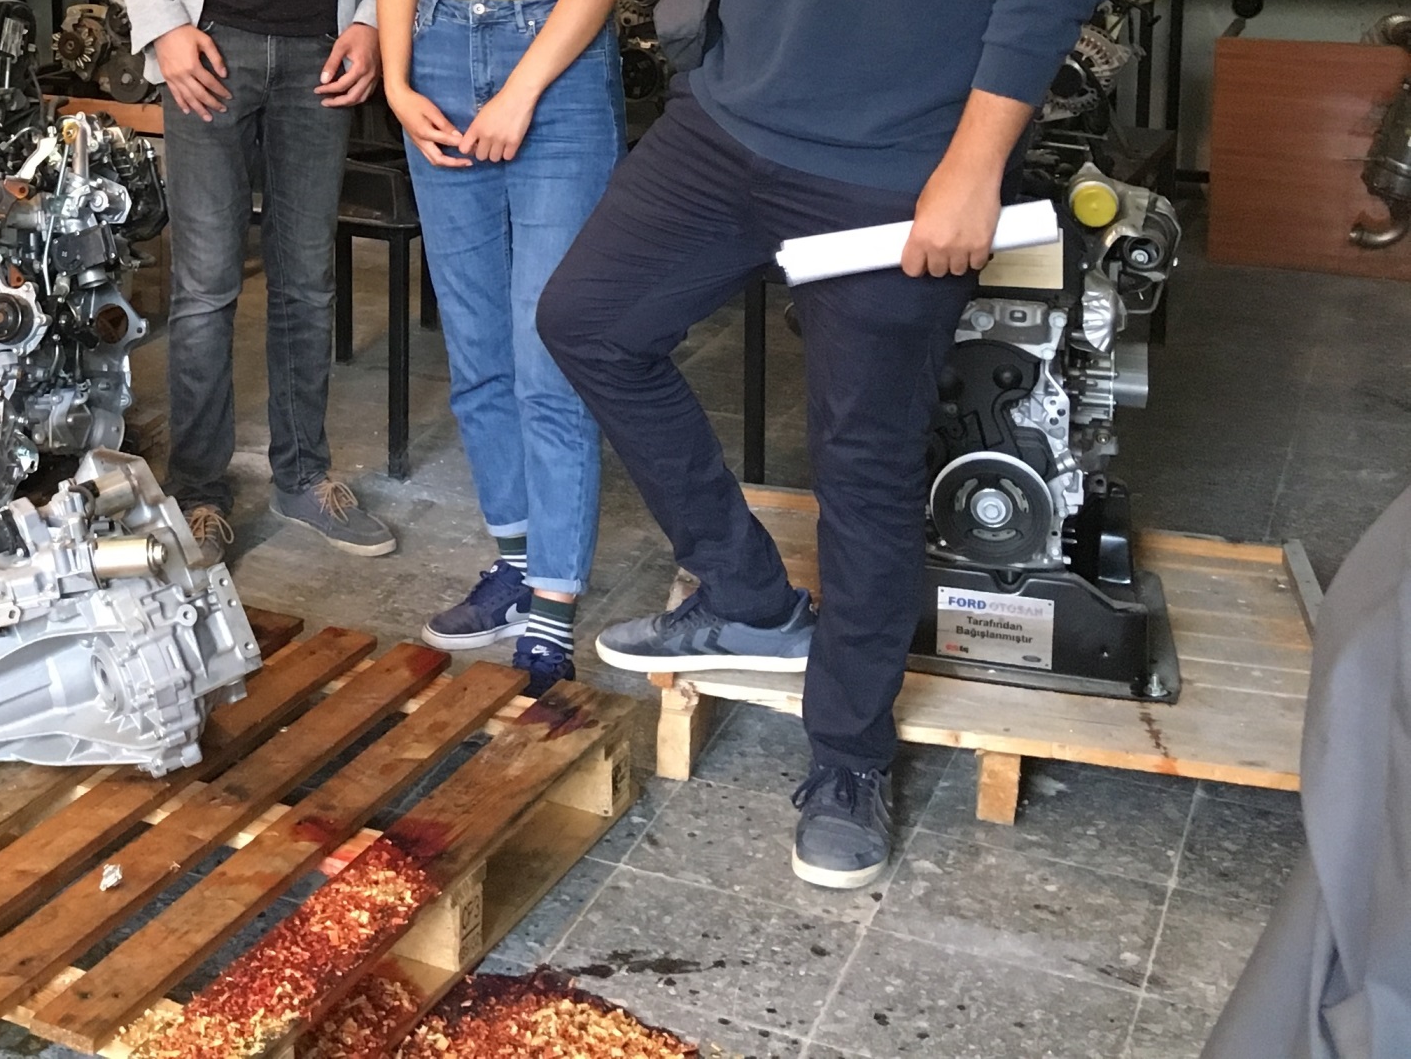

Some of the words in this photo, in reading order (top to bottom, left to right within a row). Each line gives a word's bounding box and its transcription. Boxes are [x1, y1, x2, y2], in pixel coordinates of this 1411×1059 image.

[948, 596, 987, 610] FORD
[989, 602, 1044, 617] OTOSAN
[966, 616, 1023, 632] Tarafından
[955, 625, 1034, 644] Bağışlanmıştır
